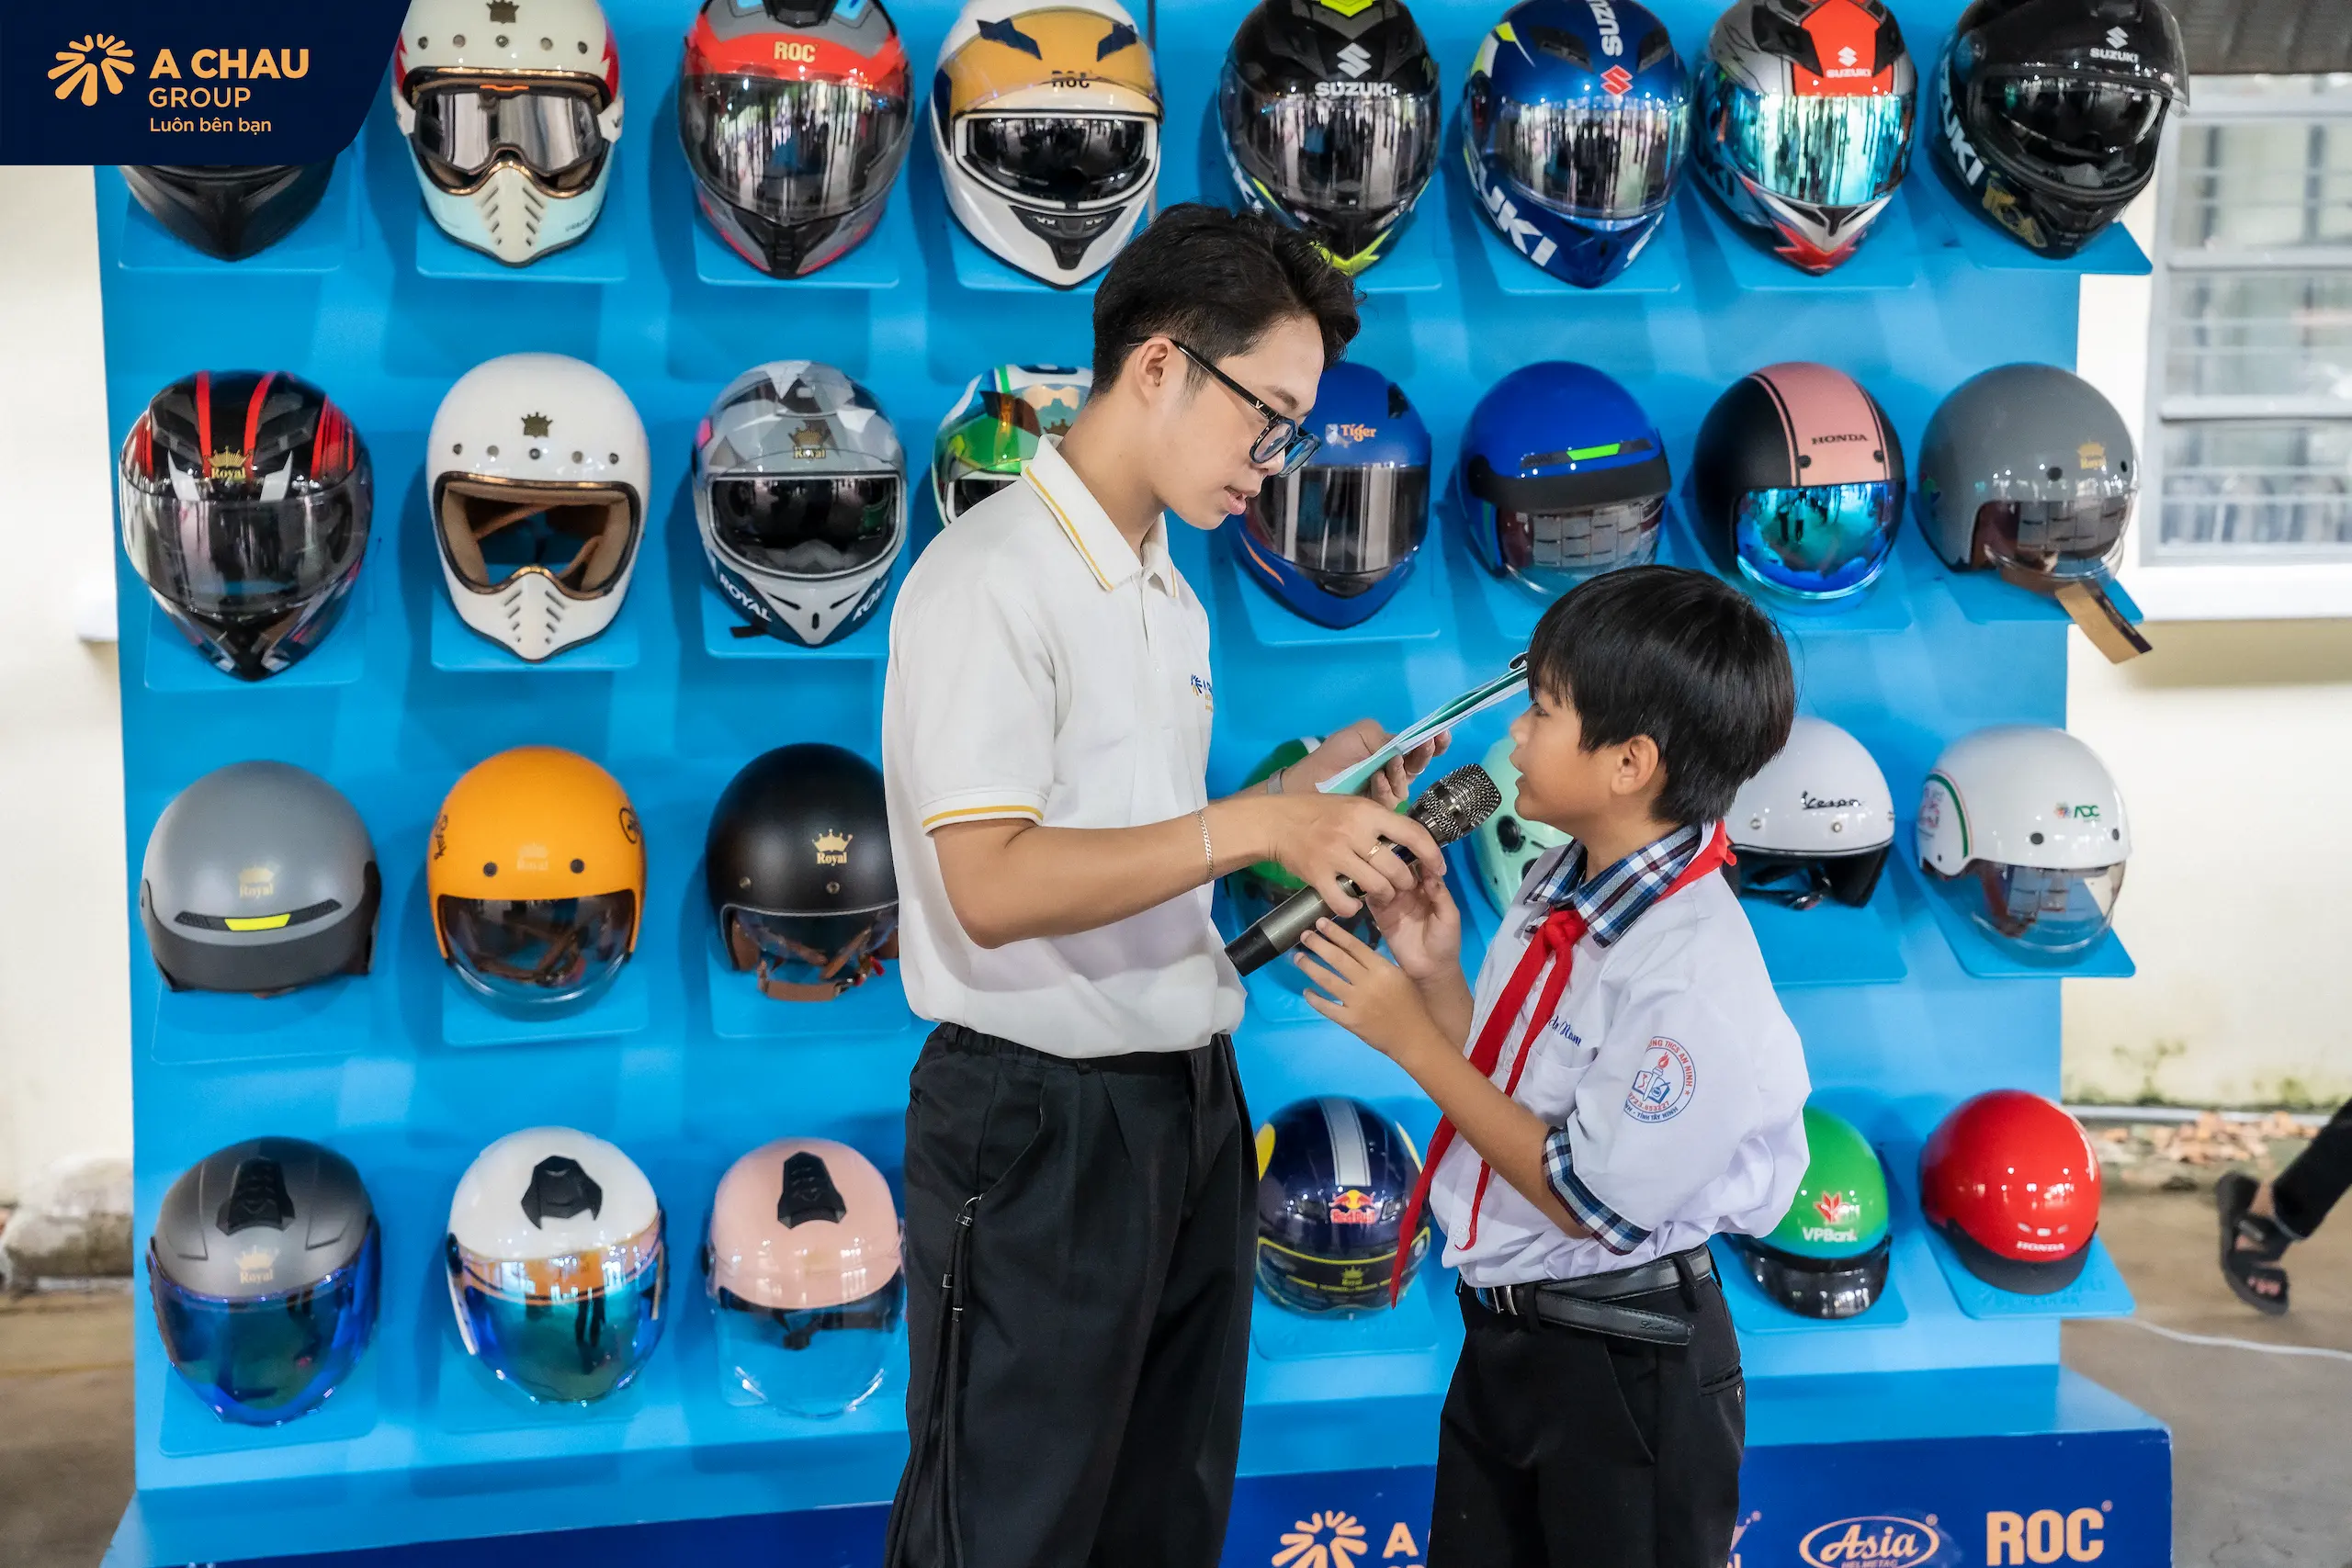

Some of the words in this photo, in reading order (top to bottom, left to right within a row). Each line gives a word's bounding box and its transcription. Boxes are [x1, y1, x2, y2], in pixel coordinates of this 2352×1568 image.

[1587, 0, 1623, 57] SUZ
[774, 40, 816, 63] ROC
[2089, 47, 2139, 63] SUZUKI
[1826, 68, 1872, 79] SUZUKI
[1314, 81, 1393, 99] SUZUKI
[1340, 423, 1377, 442] Tiger
[1811, 434, 1867, 446] HONDA
[211, 467, 246, 486] Royal
[719, 573, 773, 622] ROYAL
[1801, 791, 1862, 810] Vespa
[516, 858, 548, 874] Royal
[817, 852, 847, 866] Royal
[239, 883, 274, 899] Royal
[1665, 1041, 1680, 1054] THCS
[1678, 1053, 1690, 1064] AN
[1684, 1066, 1693, 1088] NINH
[1802, 1226, 1858, 1243] VPBank
[2017, 1240, 2065, 1252] HONDA
[240, 1268, 274, 1285] Royal
[1382, 1522, 1419, 1559] A
[1820, 1524, 1892, 1562] Asia
[1986, 1507, 2105, 1566] ROC
